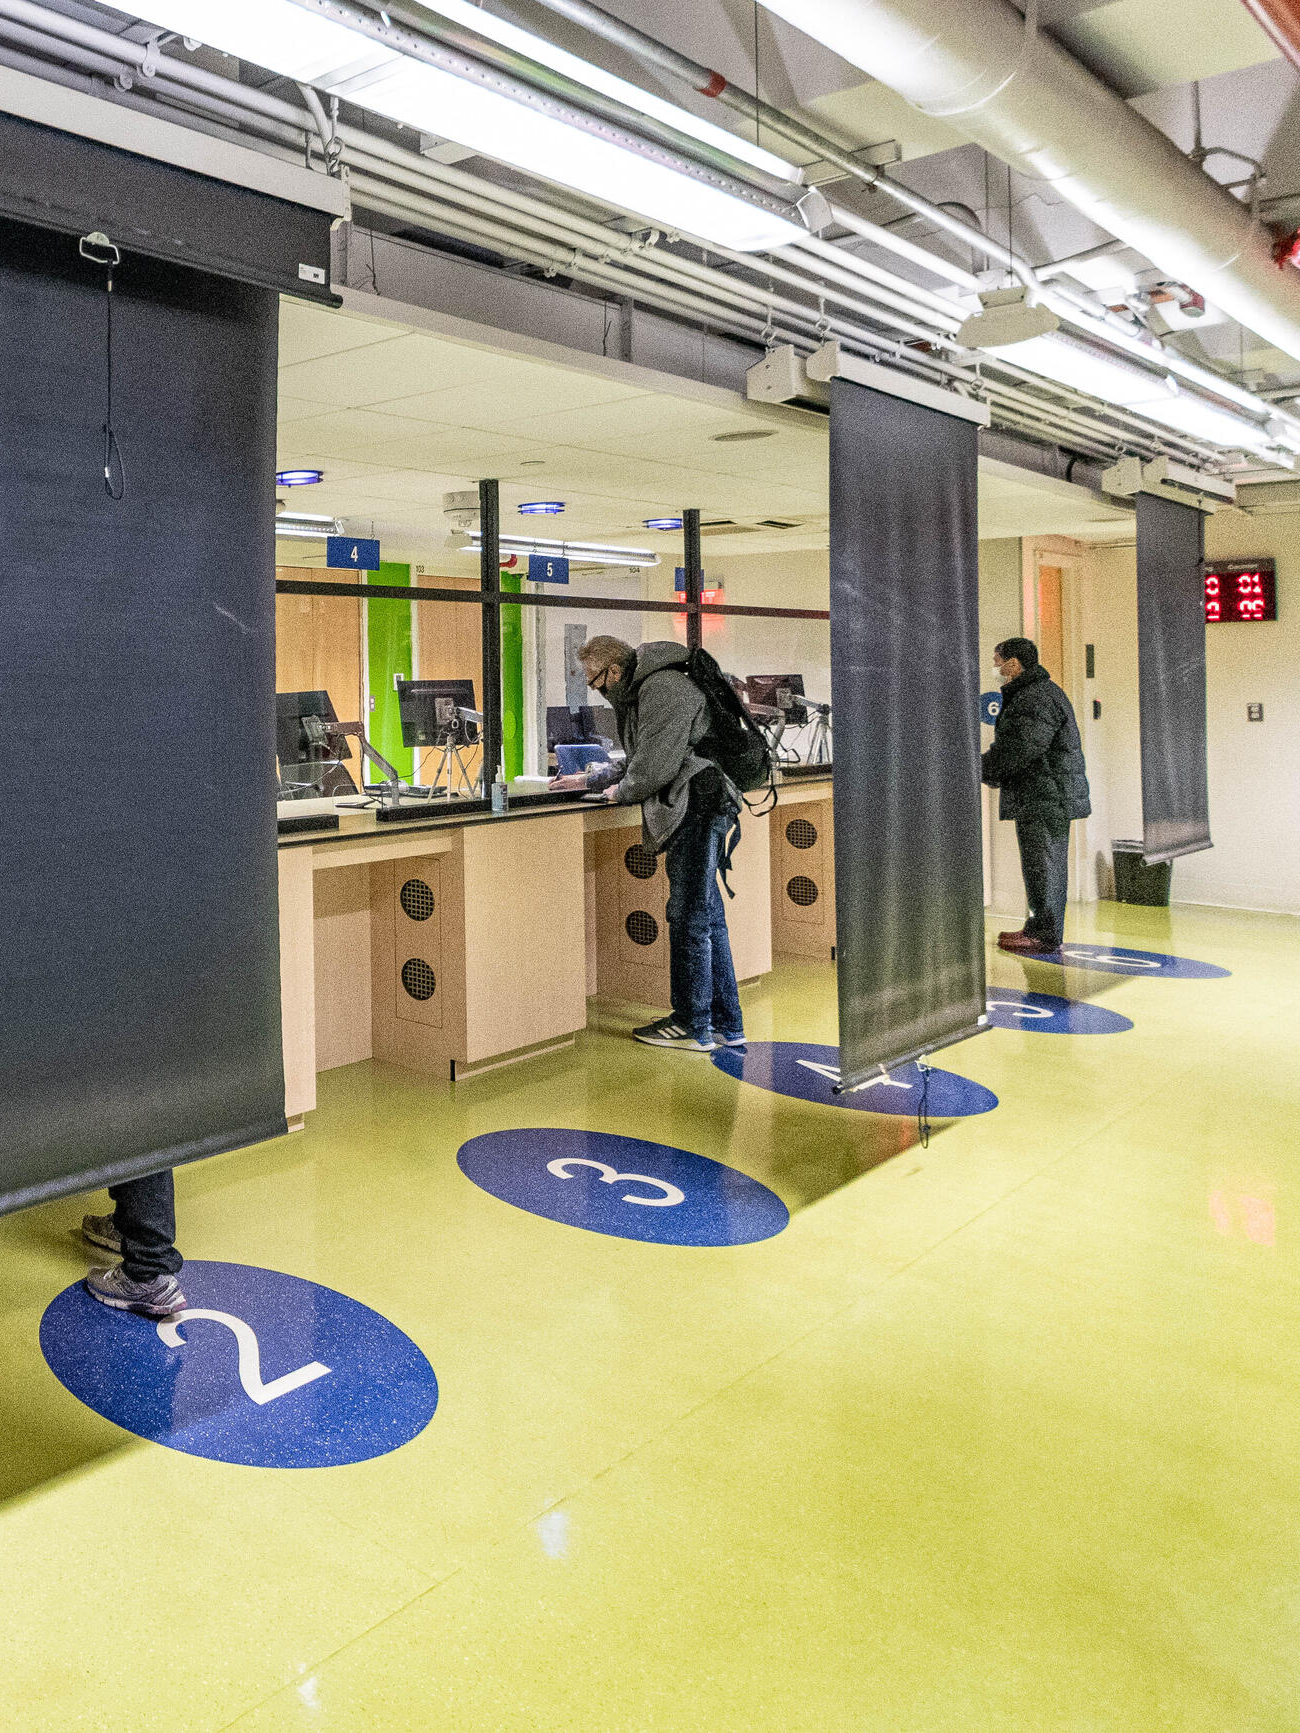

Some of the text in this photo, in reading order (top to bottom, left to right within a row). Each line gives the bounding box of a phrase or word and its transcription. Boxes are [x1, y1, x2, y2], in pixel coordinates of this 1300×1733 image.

[350, 545, 358, 562] 4
[546, 562, 553, 577] 5
[988, 702, 1000, 716] 6
[1064, 951, 1161, 968] 6
[546, 1158, 685, 1207] 3
[156, 1308, 332, 1406] 2
